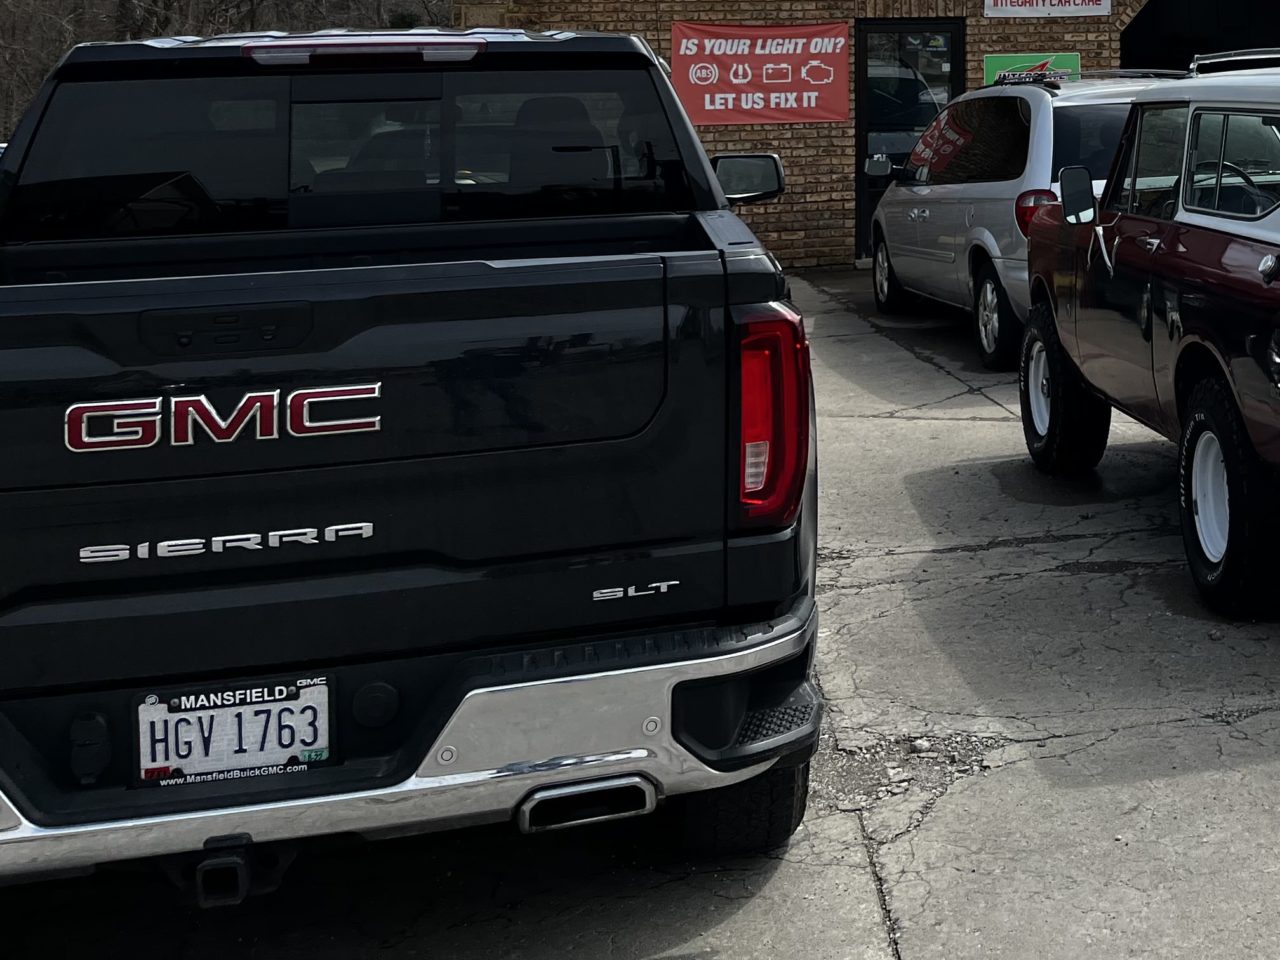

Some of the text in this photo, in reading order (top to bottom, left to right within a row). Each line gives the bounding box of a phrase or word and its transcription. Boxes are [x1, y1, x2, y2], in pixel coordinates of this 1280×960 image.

[679, 37, 845, 56] IS YOUR LIGHT ON?
[696, 69, 712, 78] ABS
[704, 91, 818, 110] LET US FIX IT
[64, 381, 381, 453] GMC
[79, 521, 374, 564] SIERRA
[592, 579, 680, 602] SLT
[297, 676, 327, 686] GMC
[180, 686, 287, 709] MANSFIELD
[150, 705, 319, 762] HGV 1763
[160, 763, 308, 786] www.MansfieldBuickGMC.com
